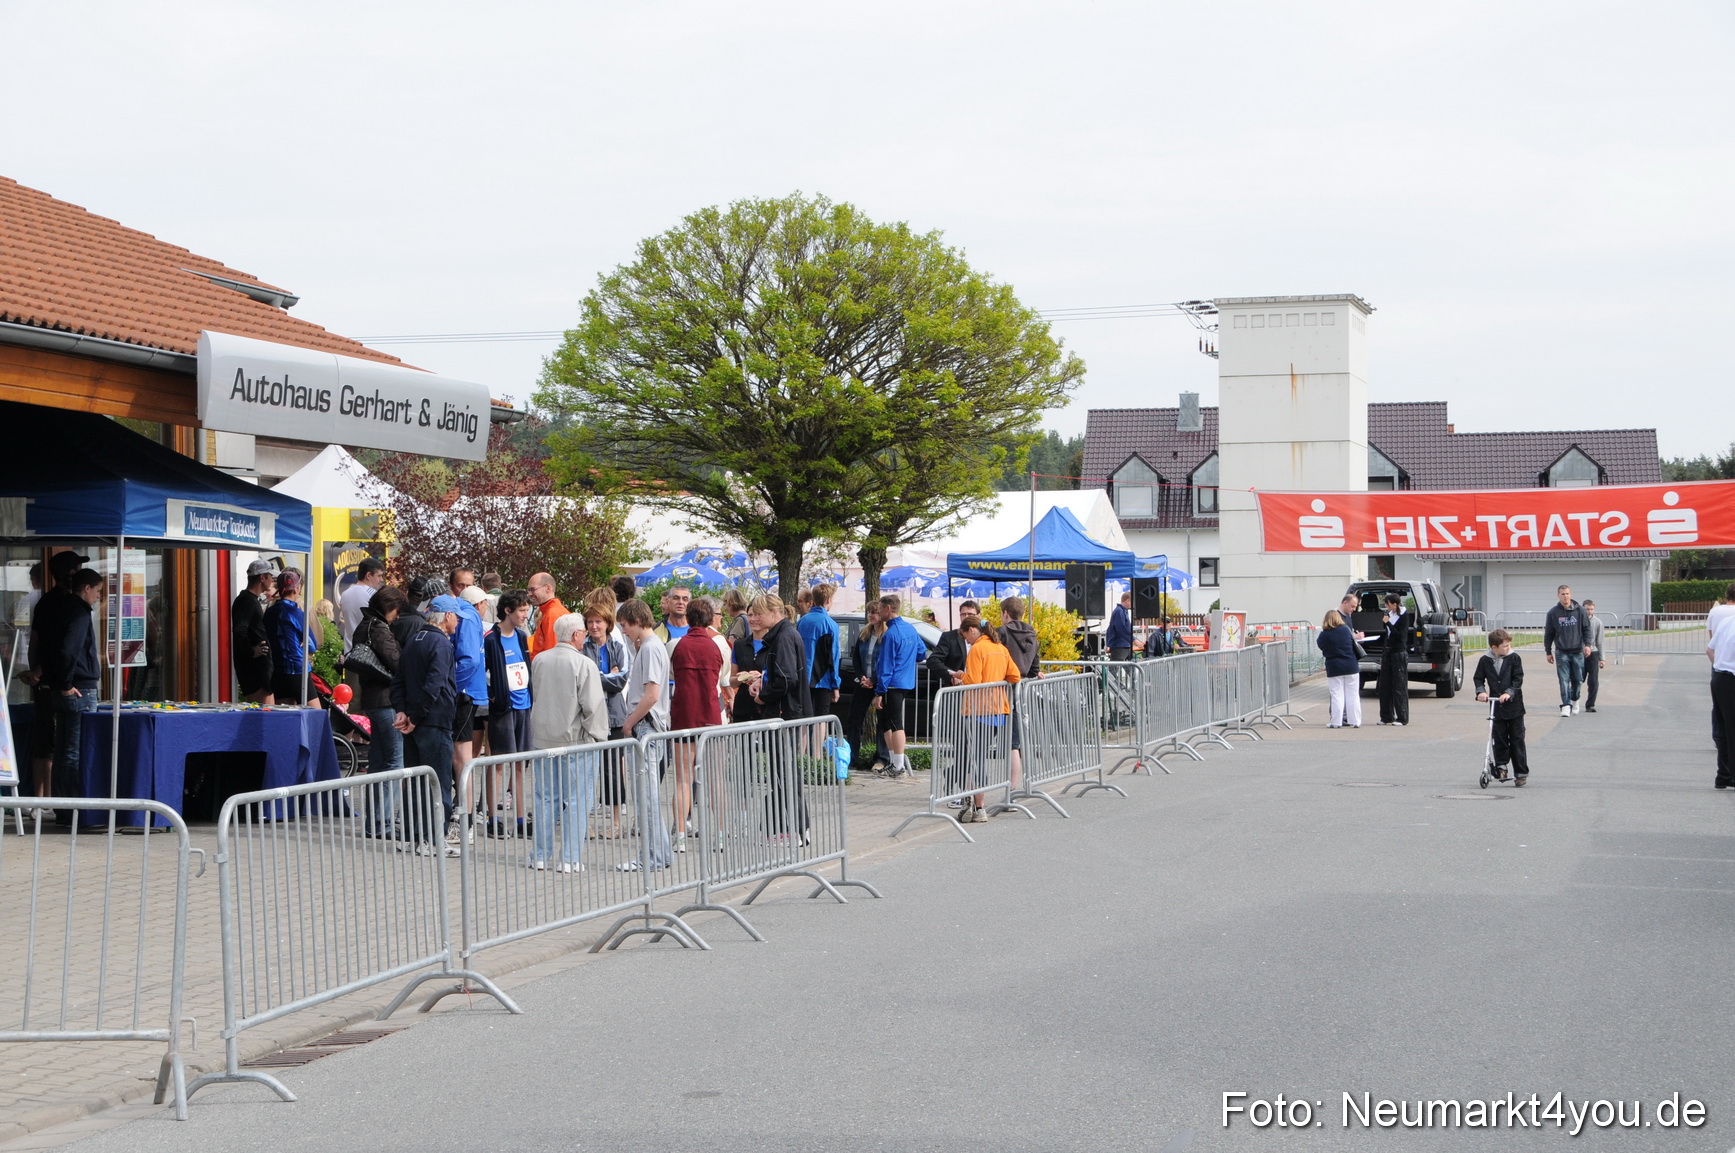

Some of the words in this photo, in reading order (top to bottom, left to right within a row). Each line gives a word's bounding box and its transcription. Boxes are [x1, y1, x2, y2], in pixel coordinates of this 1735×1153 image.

[230, 367, 331, 412] Autohaus
[339, 385, 412, 424] Gerhart
[418, 398, 431, 427] &
[437, 402, 479, 443] Jänig
[515, 671, 523, 686] 3
